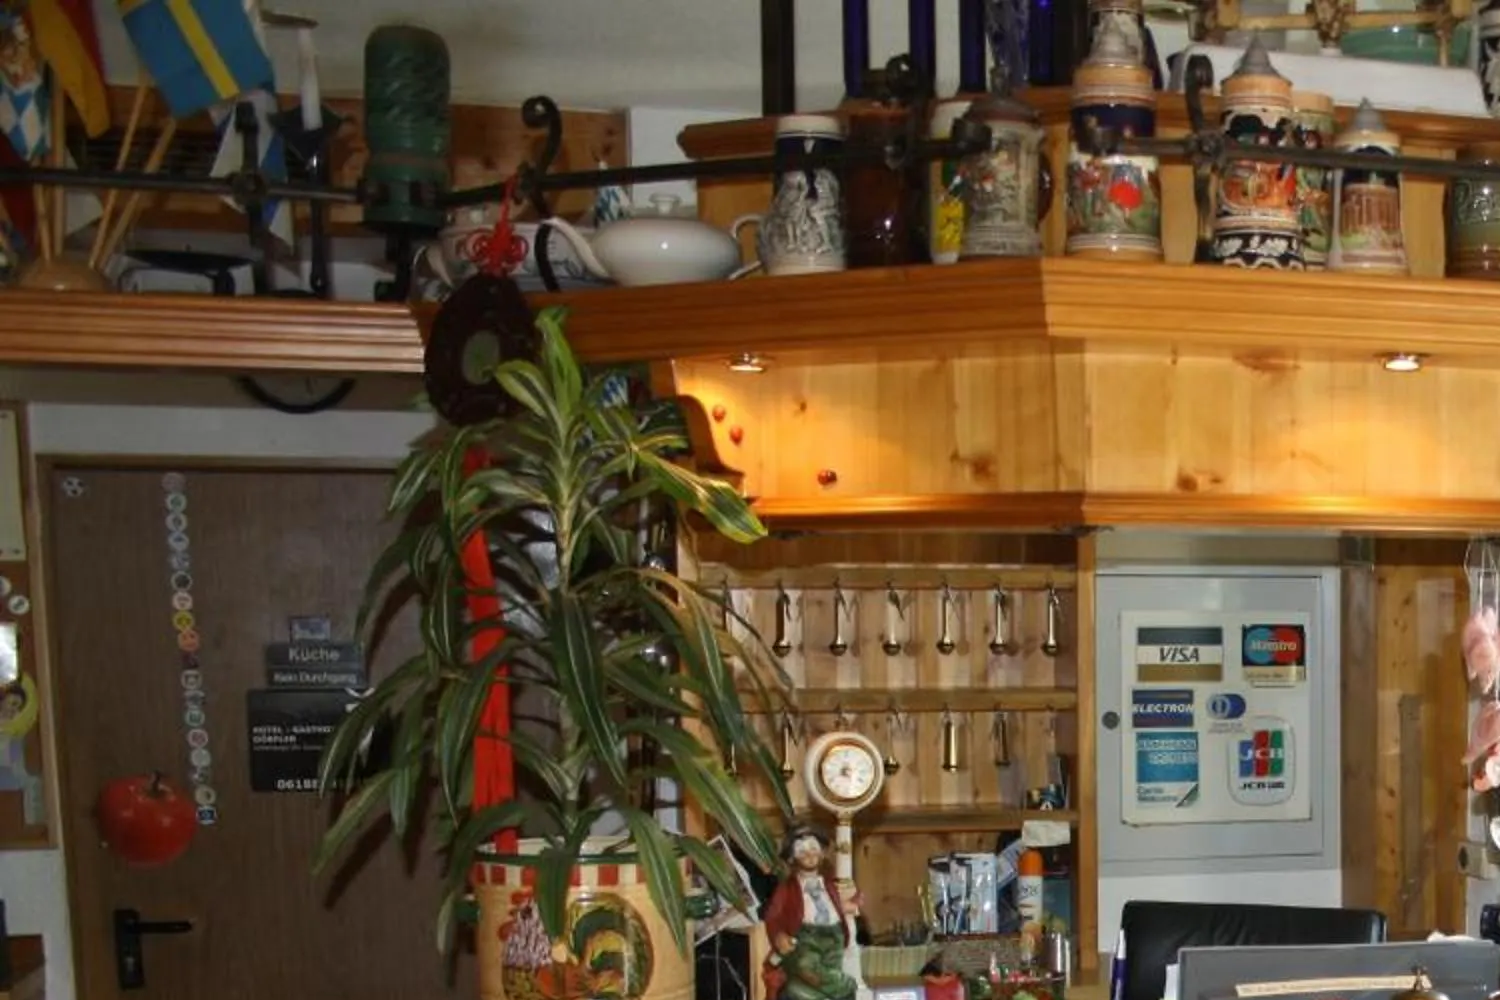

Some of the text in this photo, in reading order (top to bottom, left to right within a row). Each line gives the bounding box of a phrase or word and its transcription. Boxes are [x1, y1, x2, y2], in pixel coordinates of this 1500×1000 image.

[288, 646, 341, 662] Küche
[1158, 647, 1201, 663] VISA
[1133, 703, 1194, 713] ELECTRON
[1239, 747, 1285, 761] JCB
